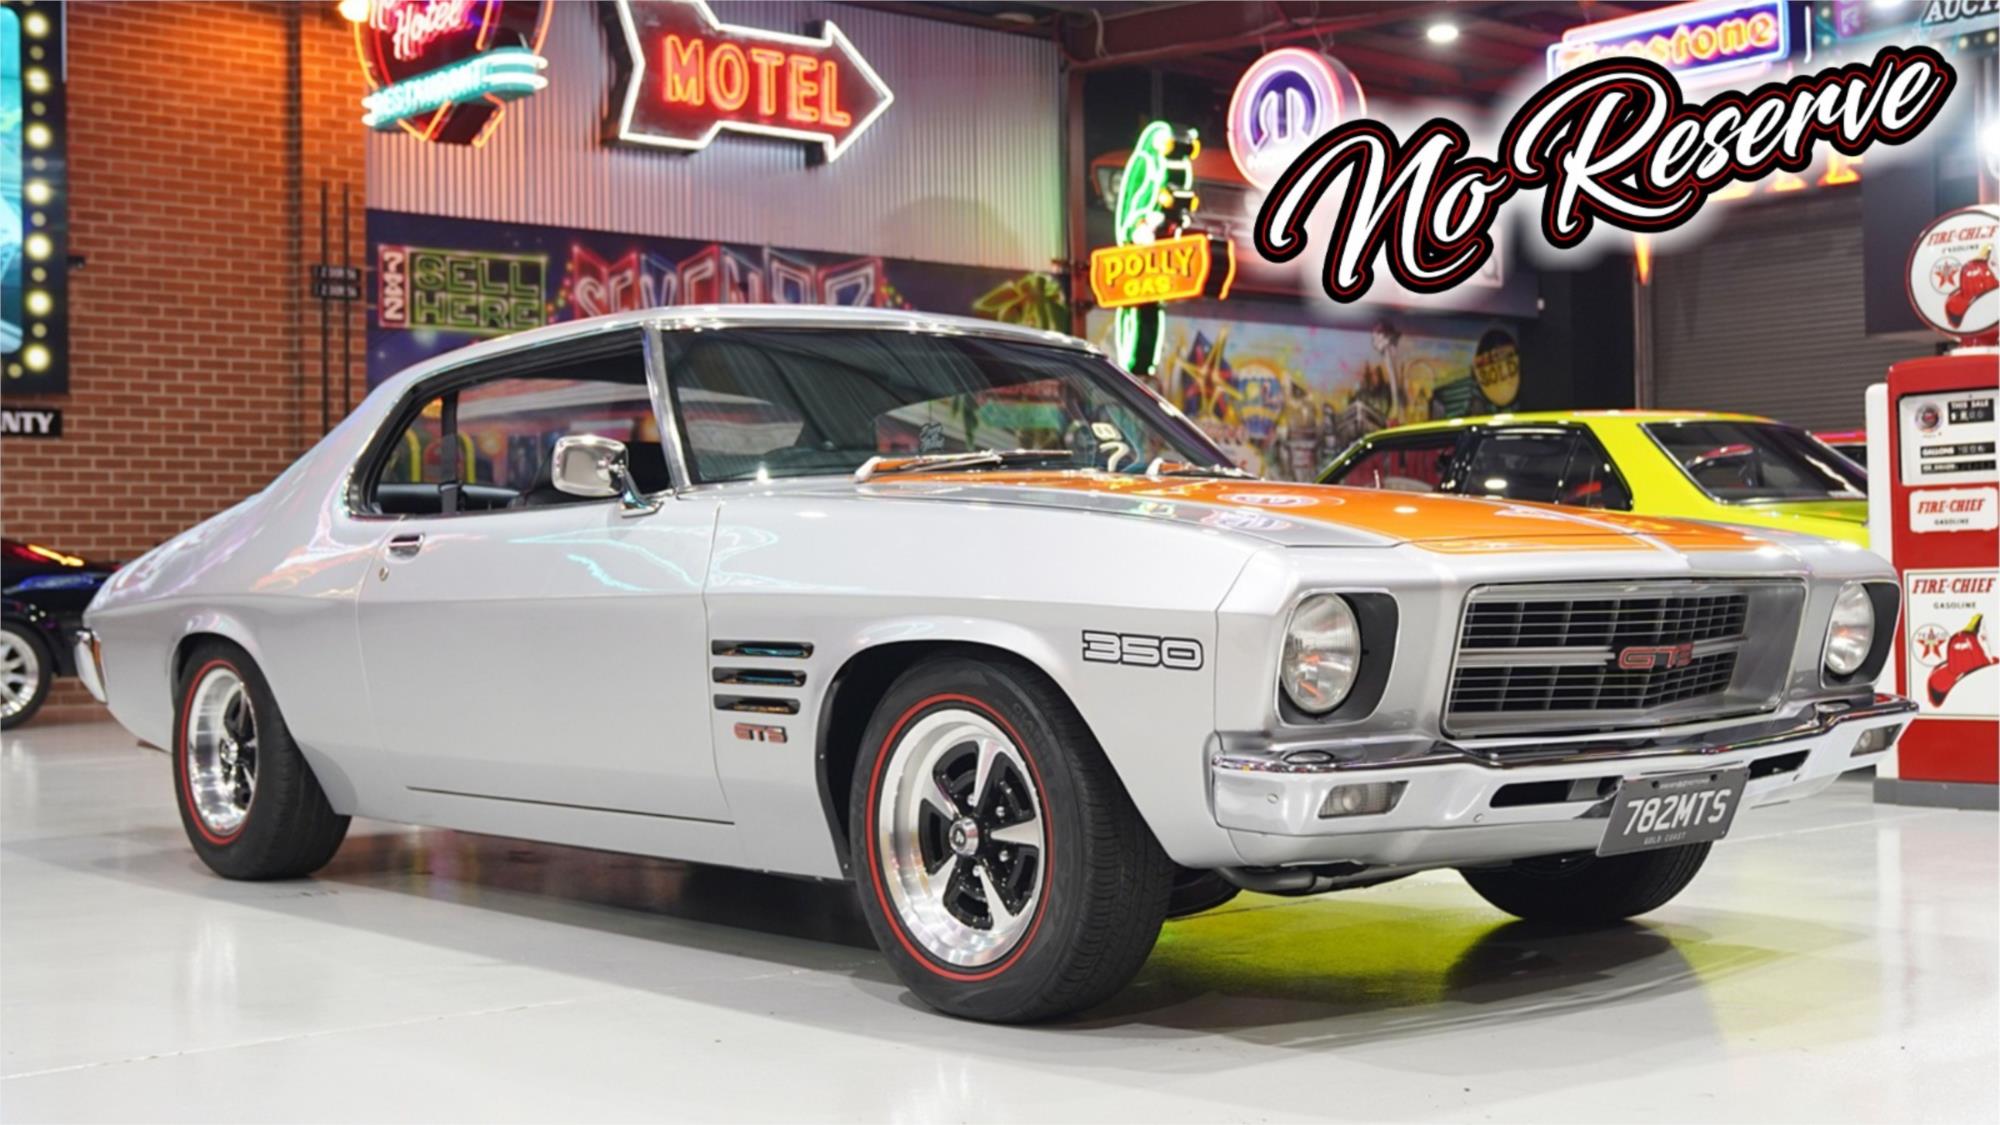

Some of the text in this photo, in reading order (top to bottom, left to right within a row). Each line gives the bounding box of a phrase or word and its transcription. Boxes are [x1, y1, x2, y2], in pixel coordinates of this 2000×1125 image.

[663, 34, 852, 127] MOTEL
[414, 254, 539, 295] SELL
[1103, 247, 1195, 287] POLLY
[1123, 274, 1170, 298] GAS
[414, 291, 540, 328] HERE
[1, 411, 54, 433] NTY
[1082, 629, 1204, 671] 350
[1618, 642, 1694, 670] GTS
[734, 722, 787, 744] GTS
[1623, 789, 1732, 836] 782MTS
